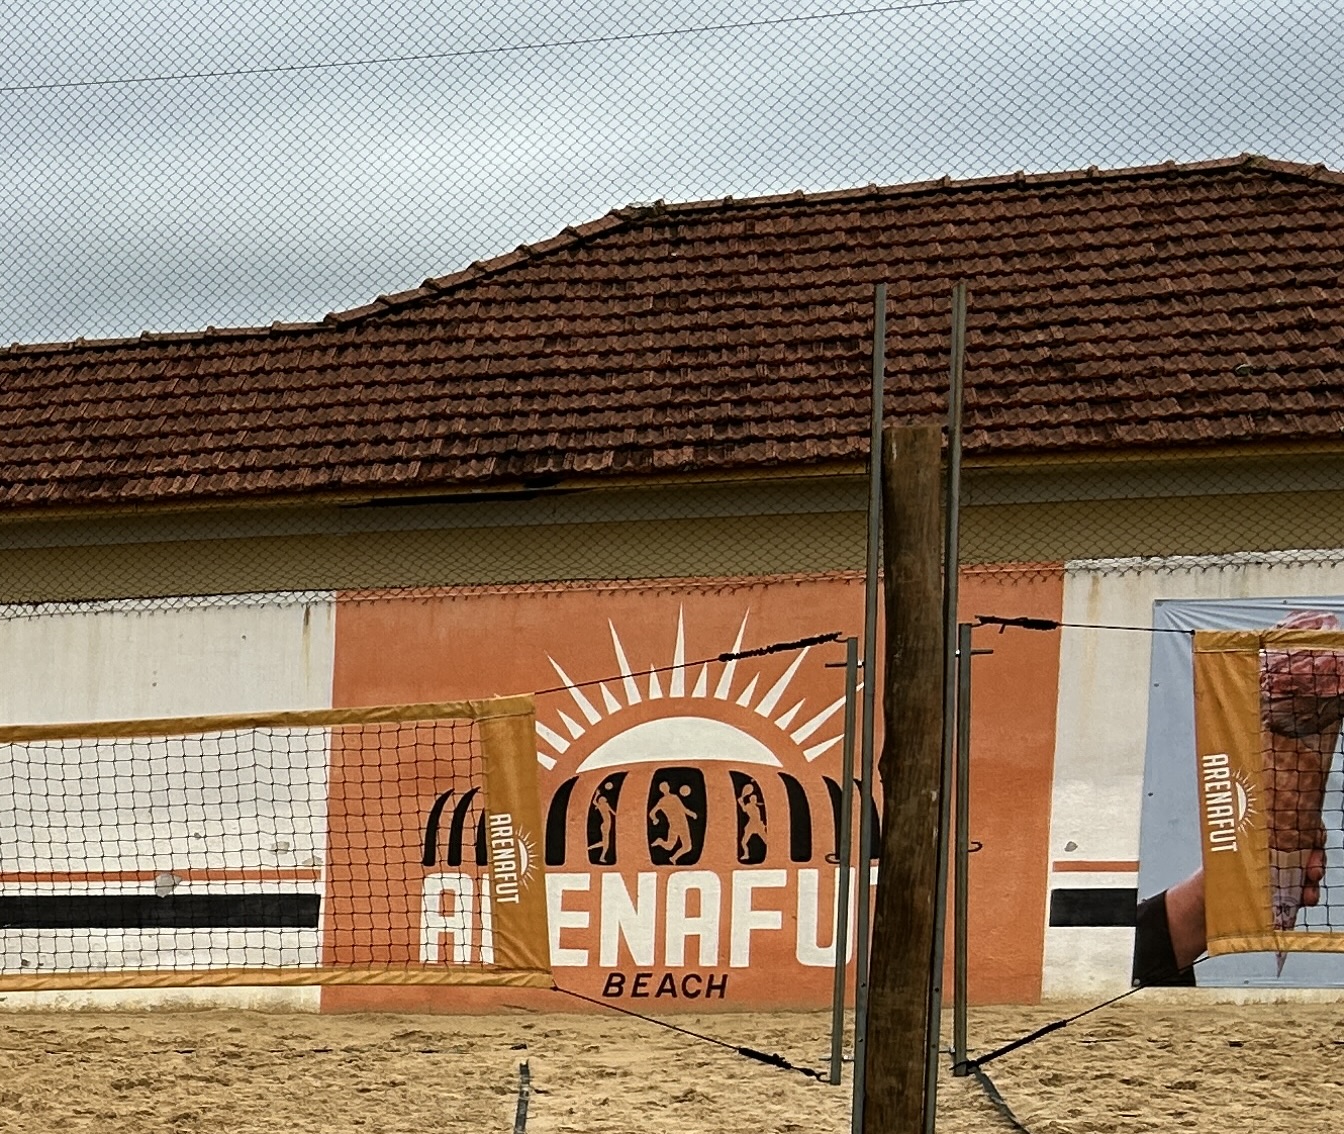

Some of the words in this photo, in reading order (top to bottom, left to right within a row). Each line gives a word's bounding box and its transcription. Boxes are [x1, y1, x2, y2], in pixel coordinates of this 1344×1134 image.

[1202, 753, 1238, 852] ARENAFUT
[489, 813, 520, 904] ARENAFUT
[419, 868, 879, 967] AENAFU
[602, 972, 728, 999] BEACH
